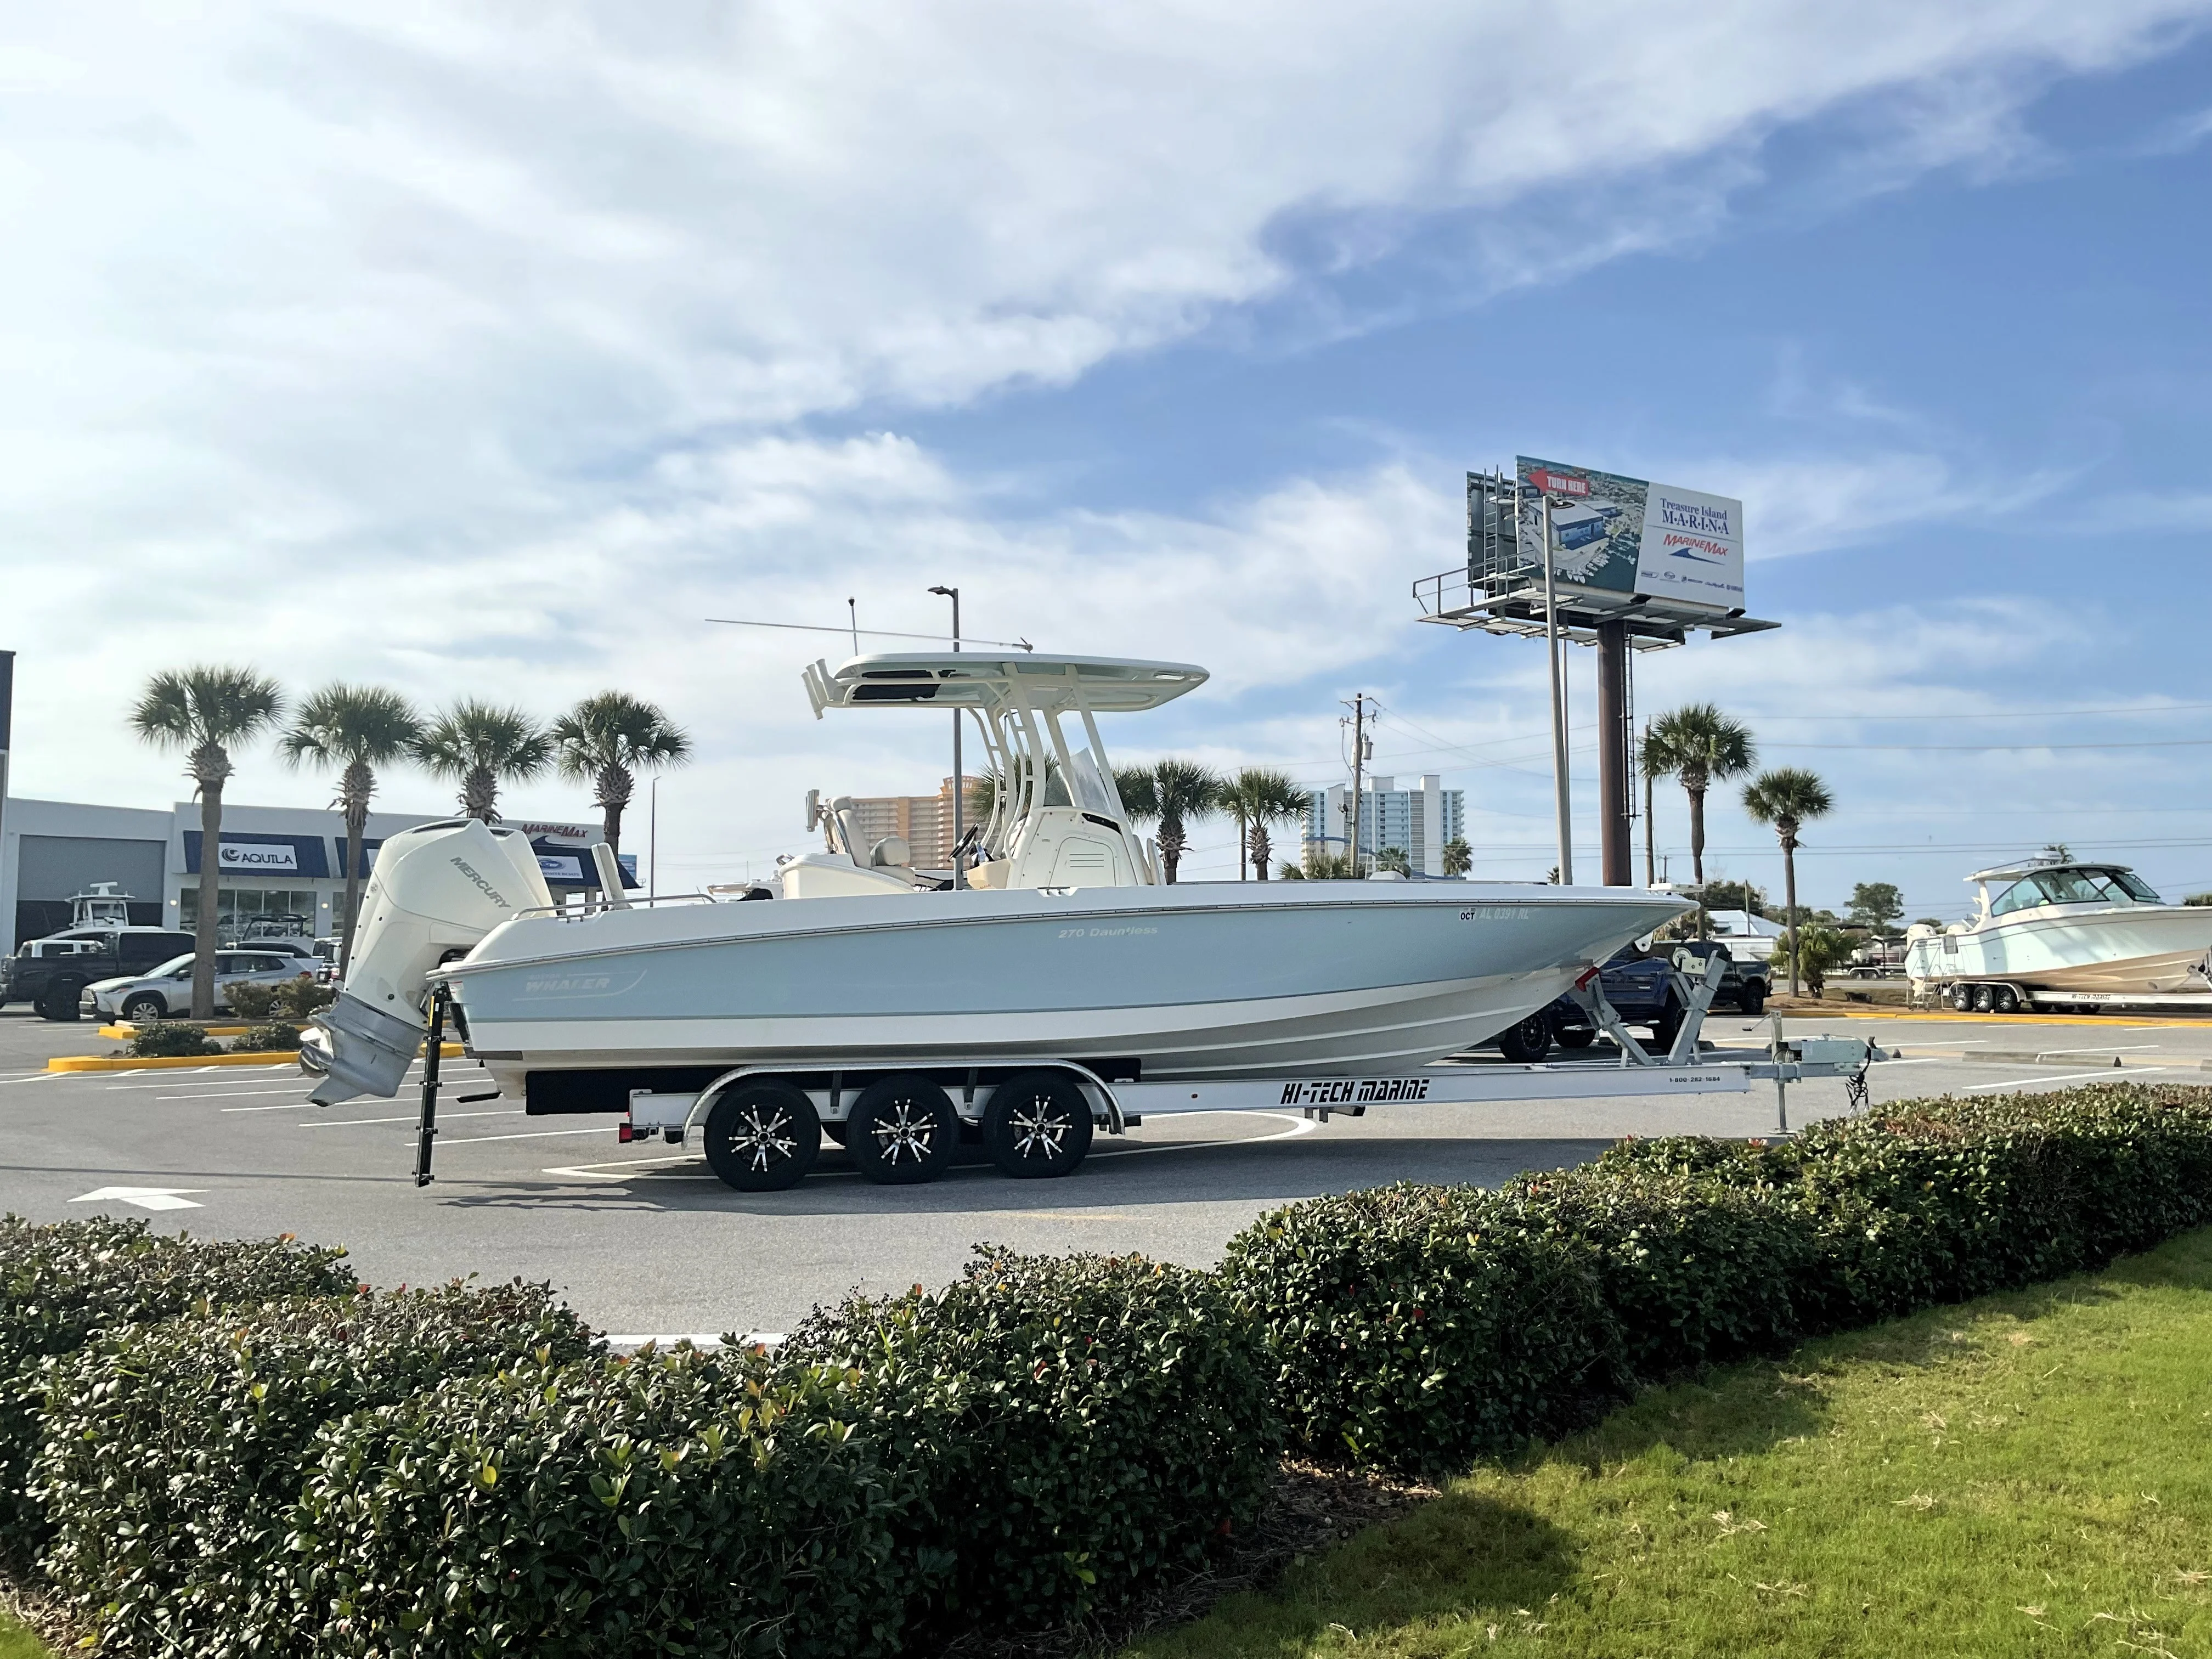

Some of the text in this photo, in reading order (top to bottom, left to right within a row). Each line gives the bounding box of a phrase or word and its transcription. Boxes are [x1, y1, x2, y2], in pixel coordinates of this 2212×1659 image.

[1547, 476, 1585, 494] TURN HERE
[1660, 498, 1727, 520] Treasure Island
[241, 854, 293, 864] AQUILA
[450, 857, 511, 908] MERCURY
[1058, 926, 1158, 938] 270 Dauntless
[1280, 1079, 1430, 1104] HI-TECH MARINE
